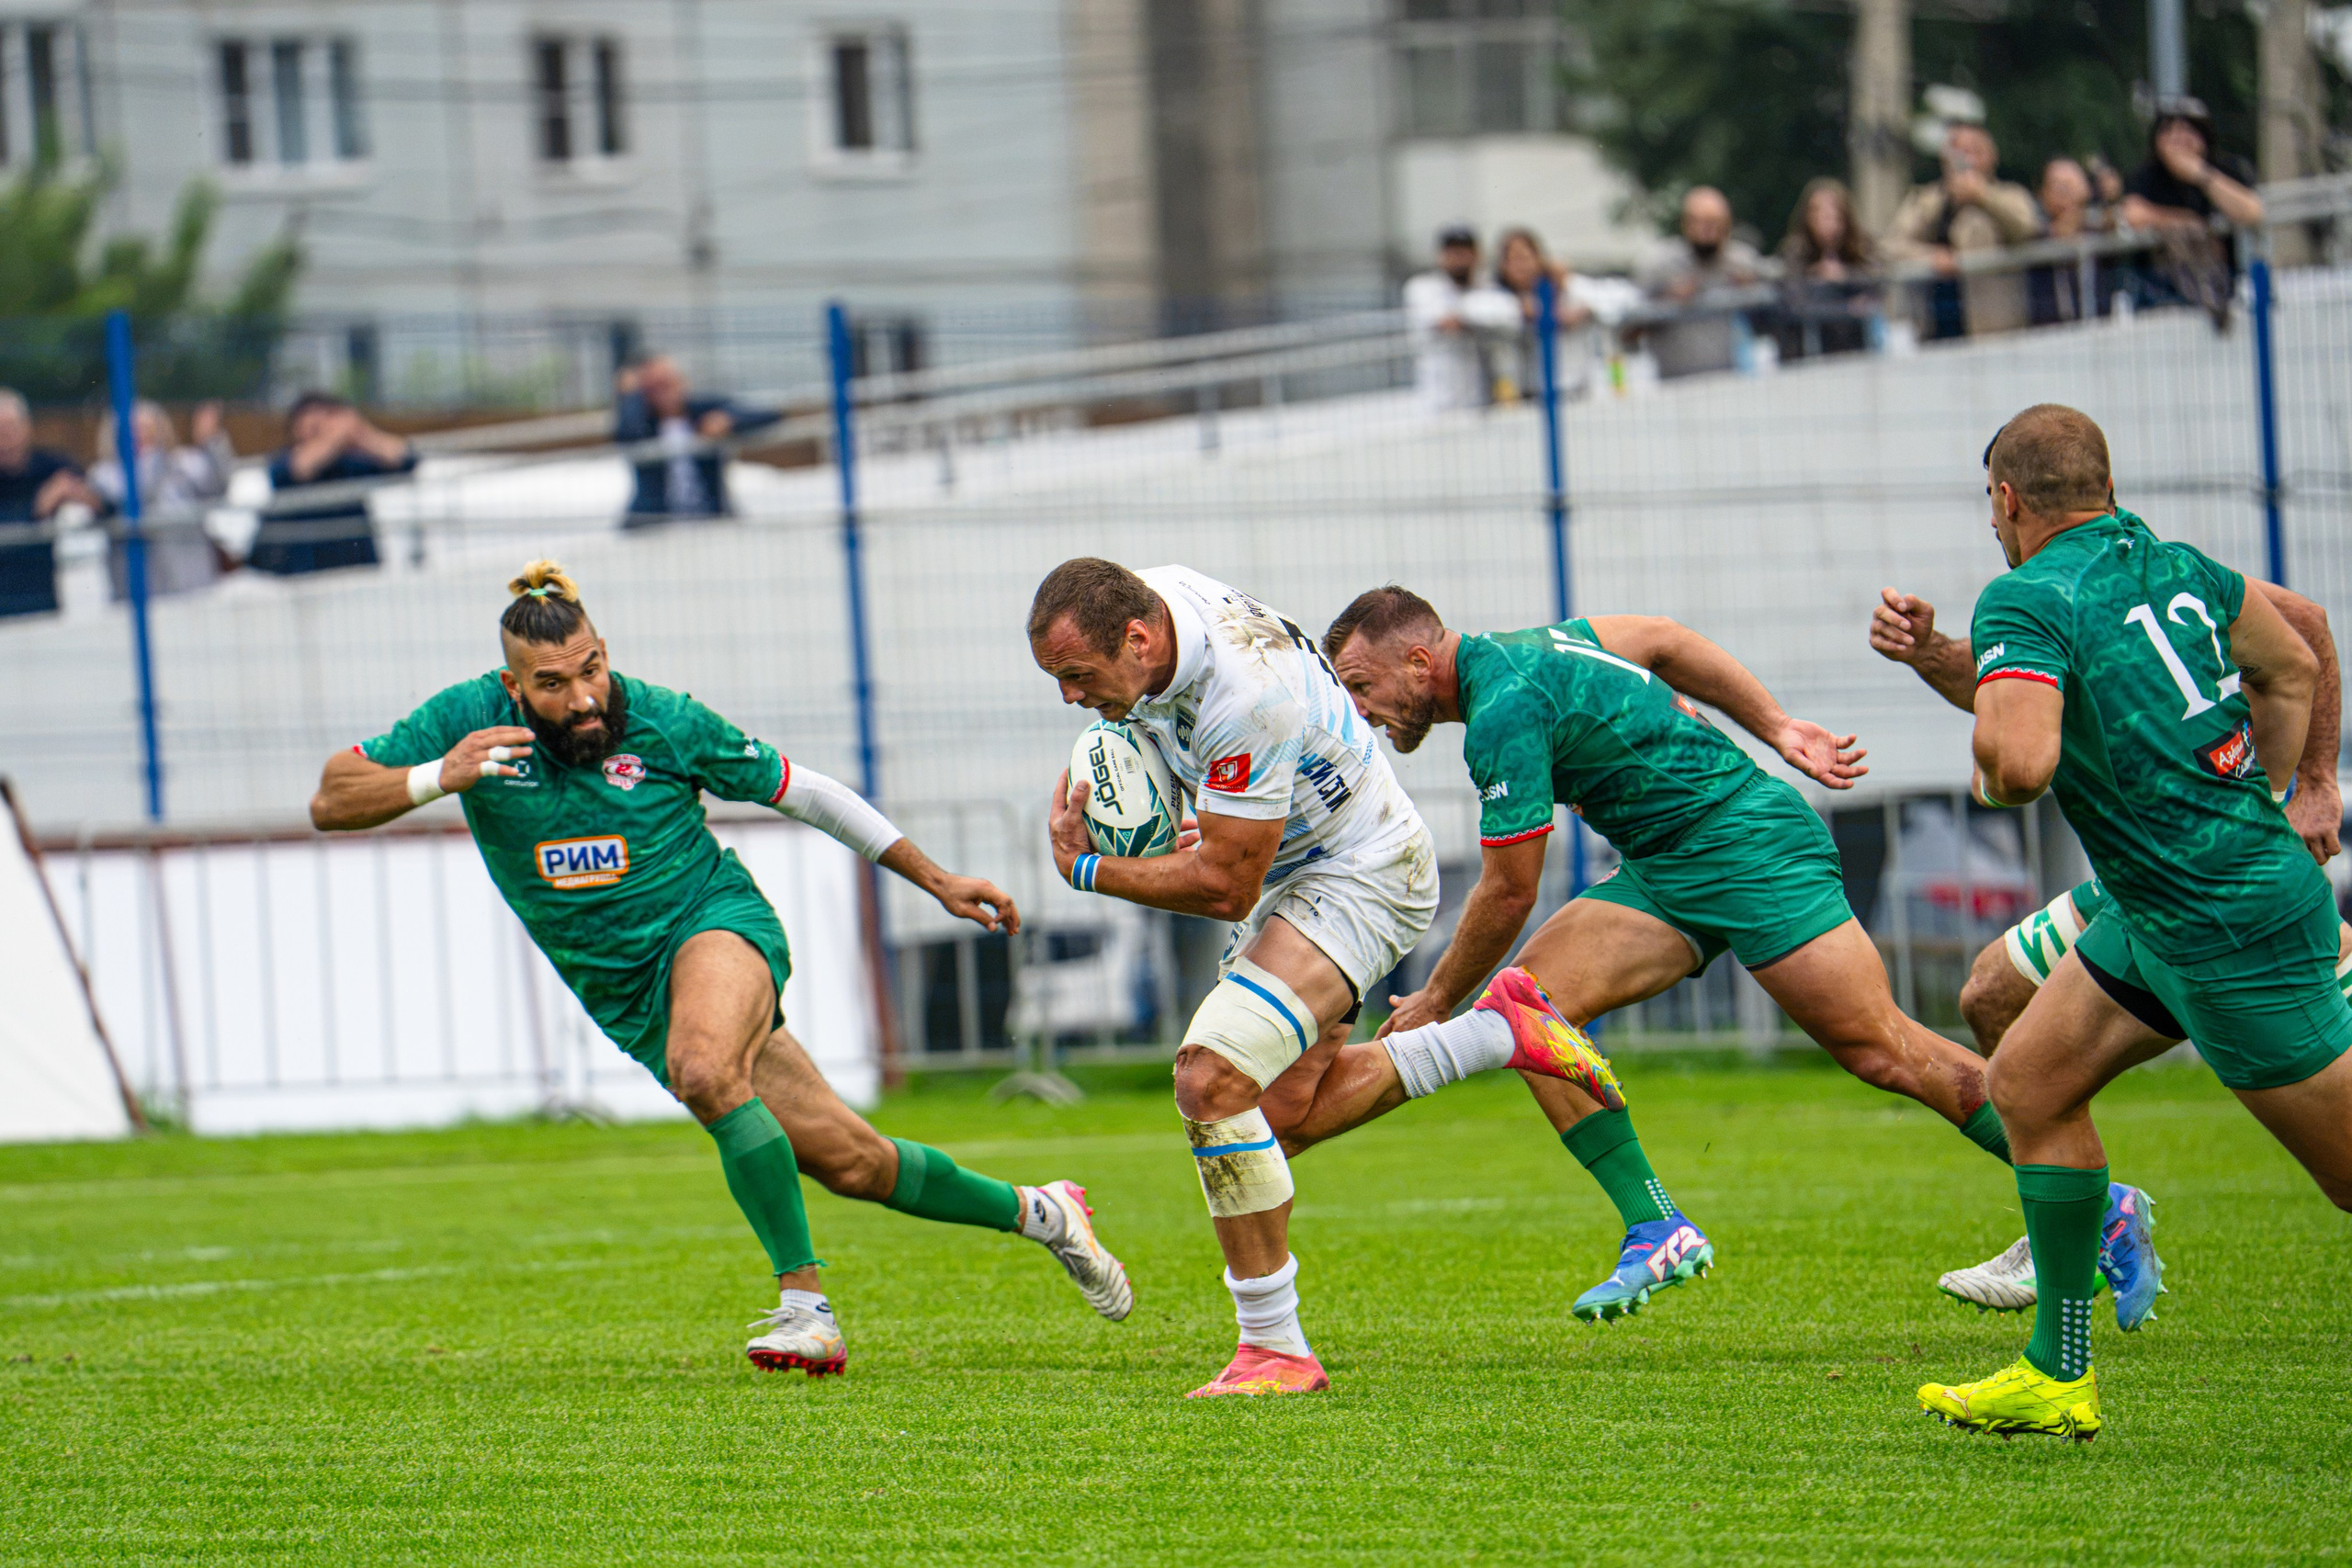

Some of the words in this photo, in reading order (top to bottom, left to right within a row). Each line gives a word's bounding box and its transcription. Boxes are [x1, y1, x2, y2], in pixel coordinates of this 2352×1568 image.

[2123, 592, 2241, 721] 12
[1088, 735, 1124, 816] JÖGEL
[1115, 771, 1125, 792] OFFICIAL
[545, 844, 619, 874] РИМ
